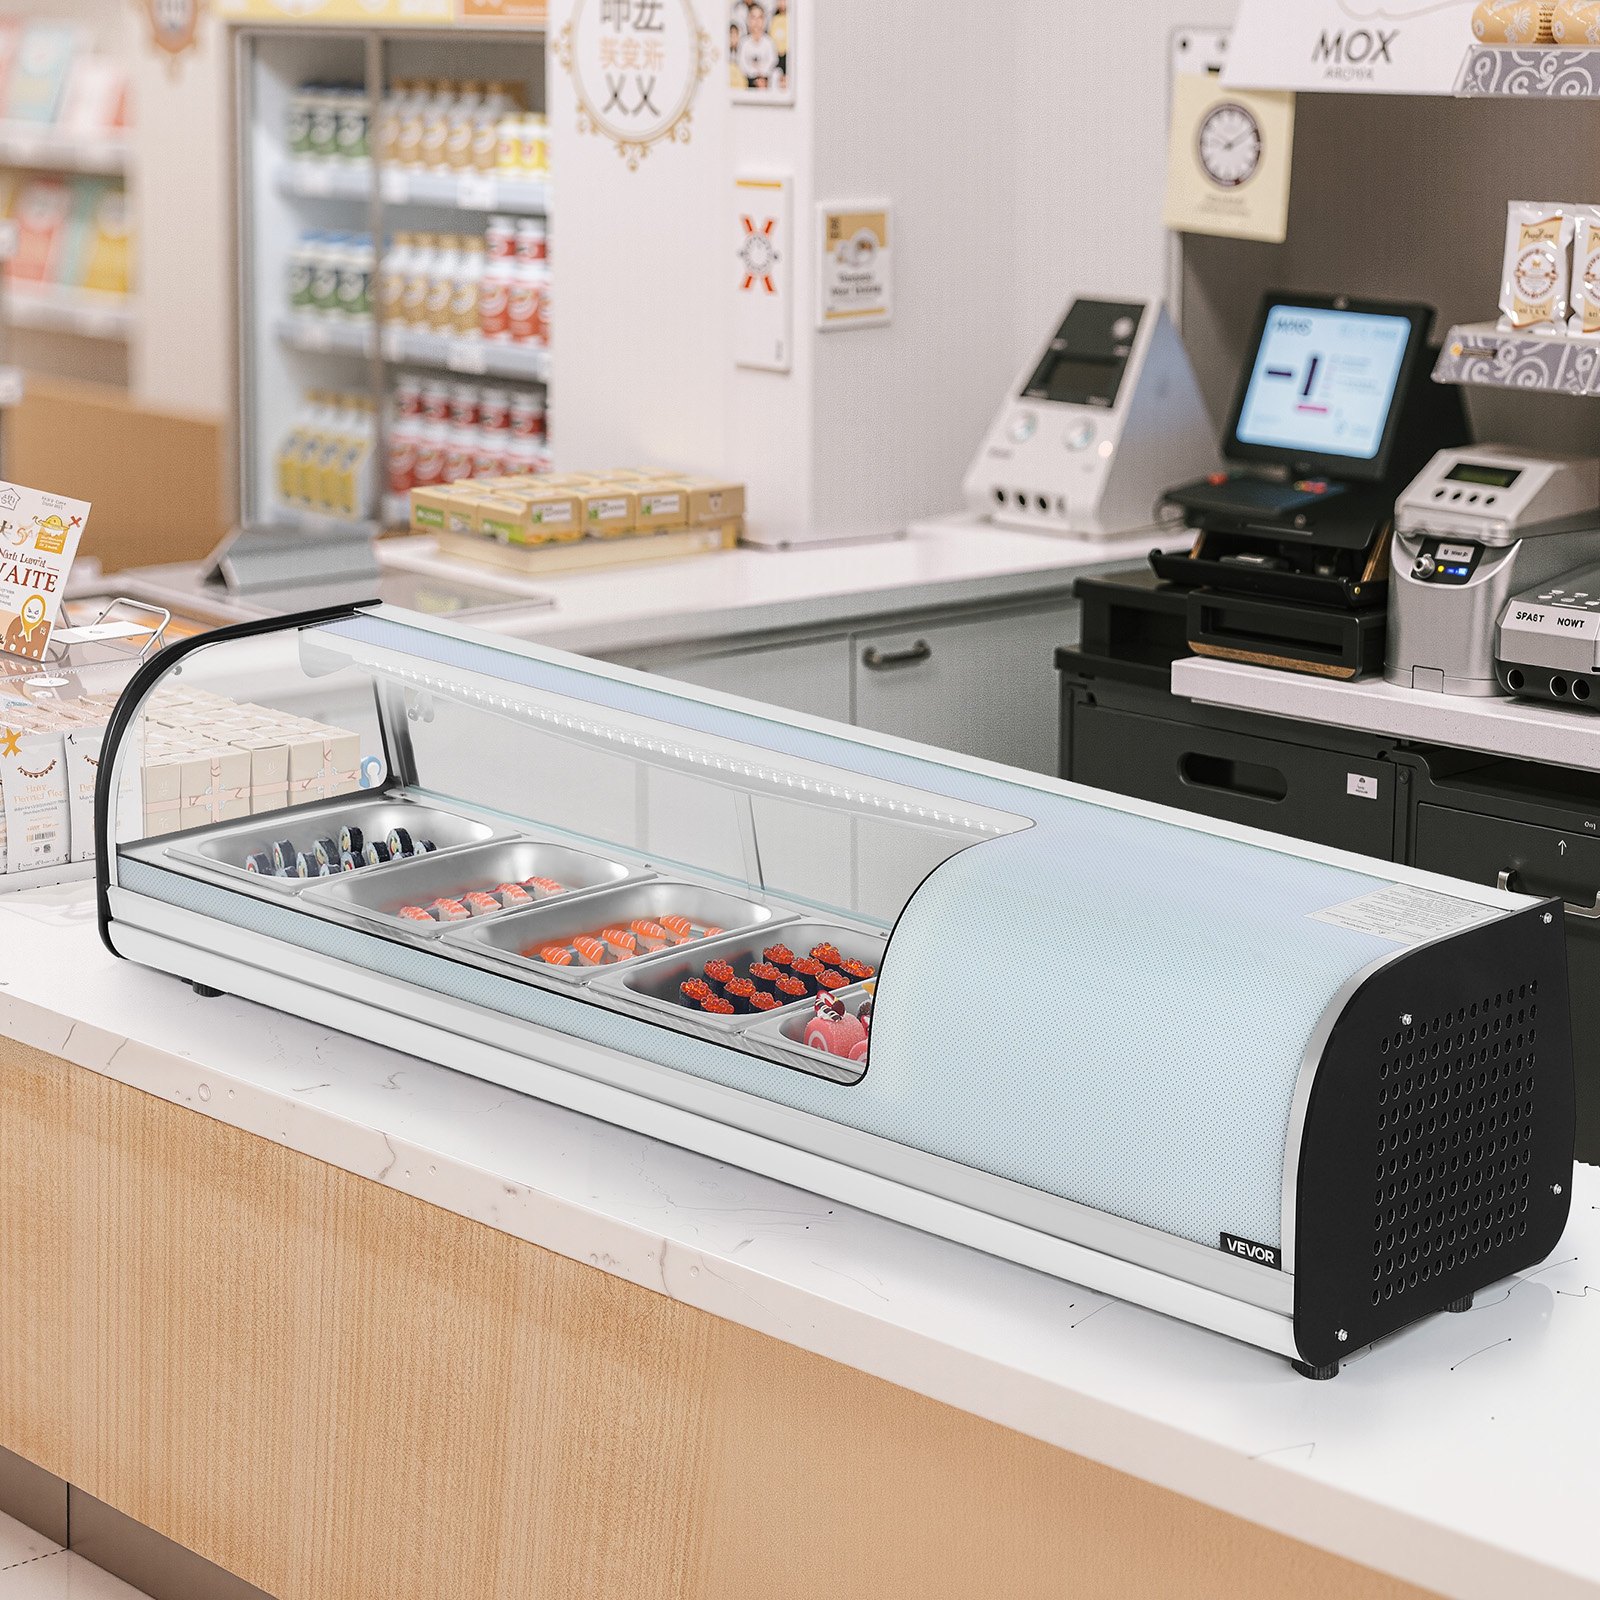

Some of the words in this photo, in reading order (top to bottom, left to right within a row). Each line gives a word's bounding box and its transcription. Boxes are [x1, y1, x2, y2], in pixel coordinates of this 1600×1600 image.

[1311, 28, 1400, 63] MOX
[1557, 617, 1585, 628] NOWT
[1226, 1237, 1275, 1264] VEVOR
